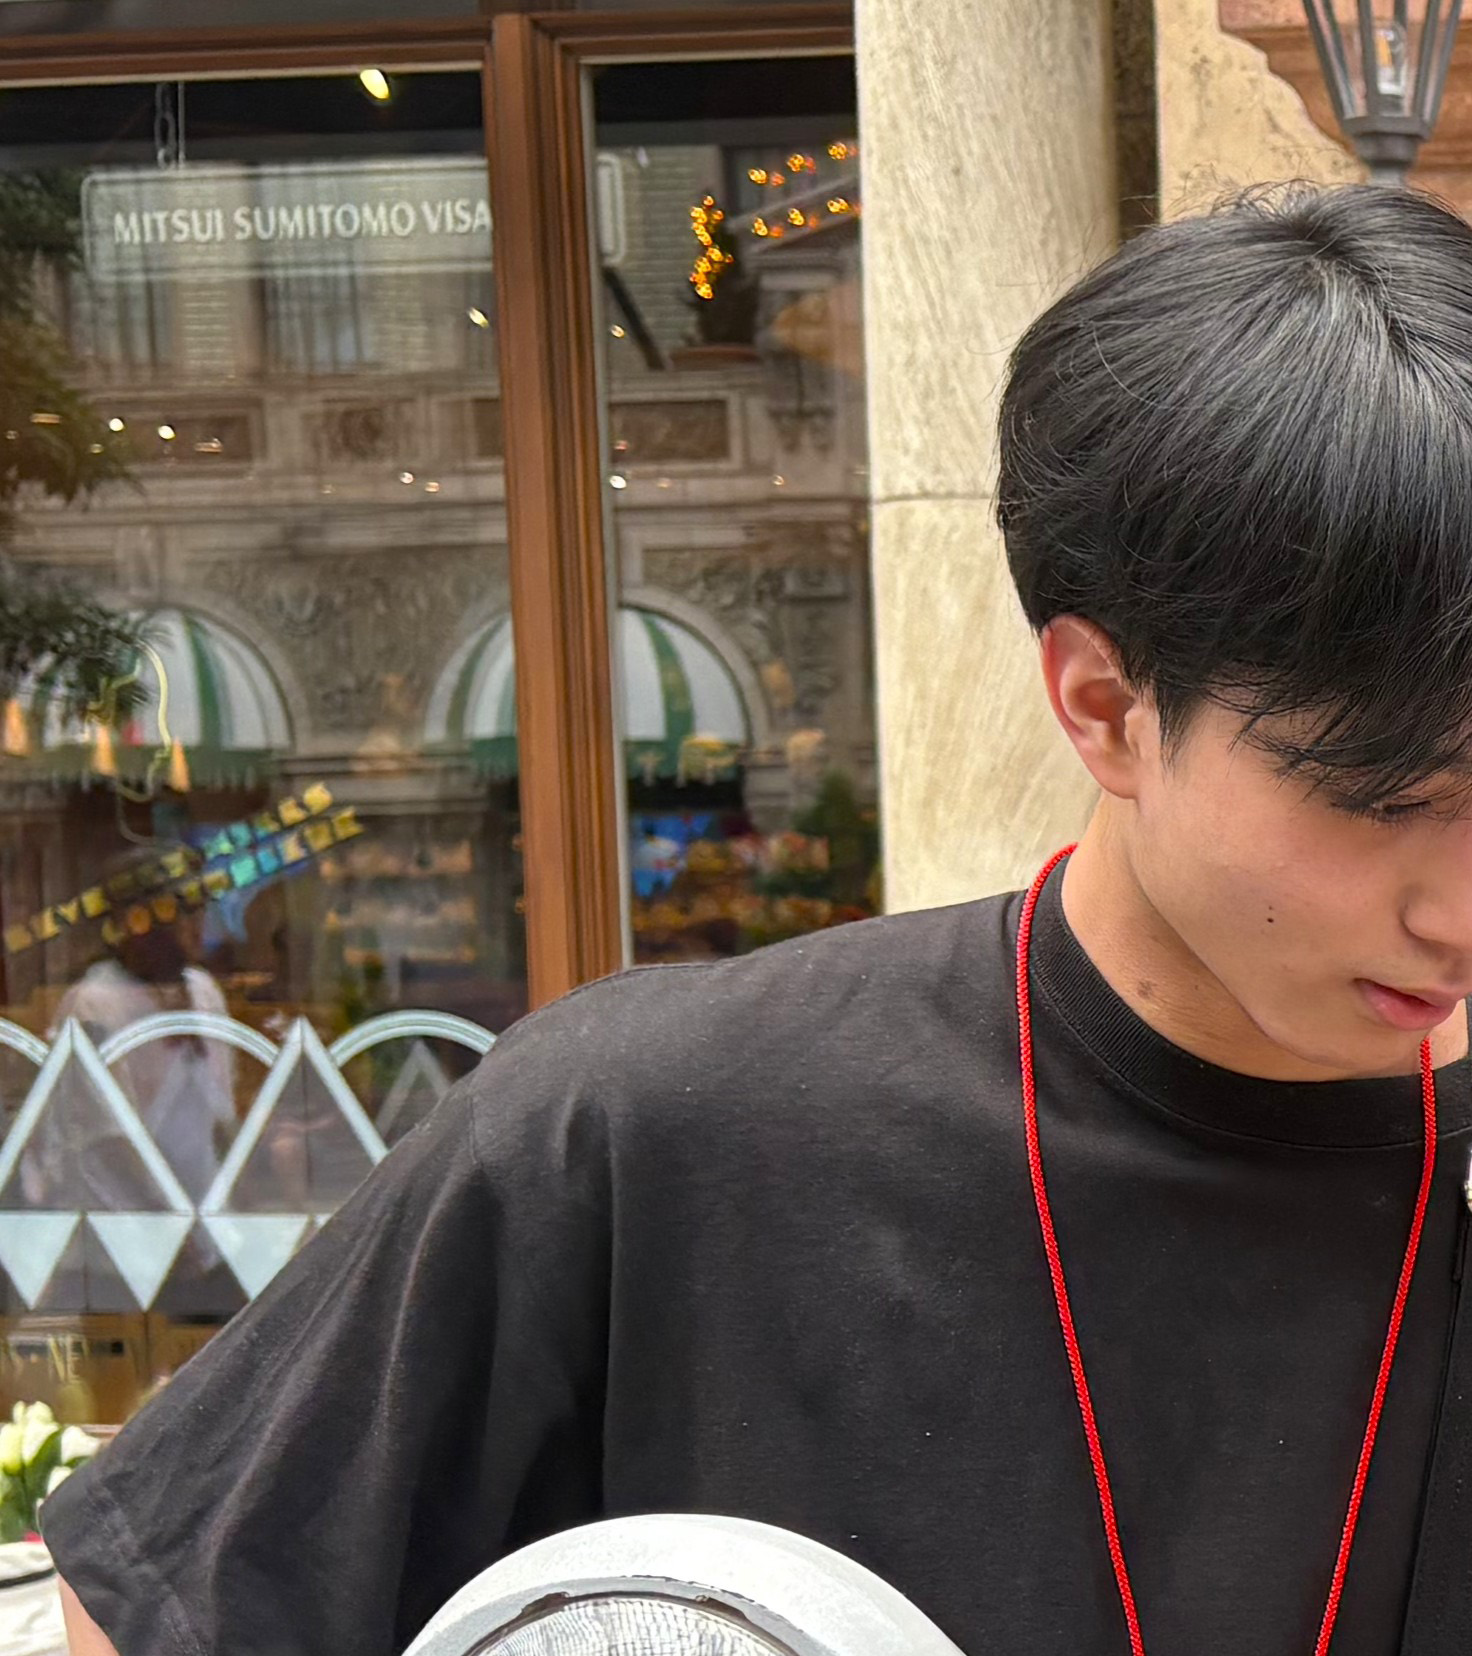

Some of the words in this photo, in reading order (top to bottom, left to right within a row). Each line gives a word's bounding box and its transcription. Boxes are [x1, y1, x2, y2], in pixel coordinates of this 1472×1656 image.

[113, 209, 225, 245] MITSUI
[233, 201, 416, 241] SUMITOMO
[419, 197, 493, 235] VISA
